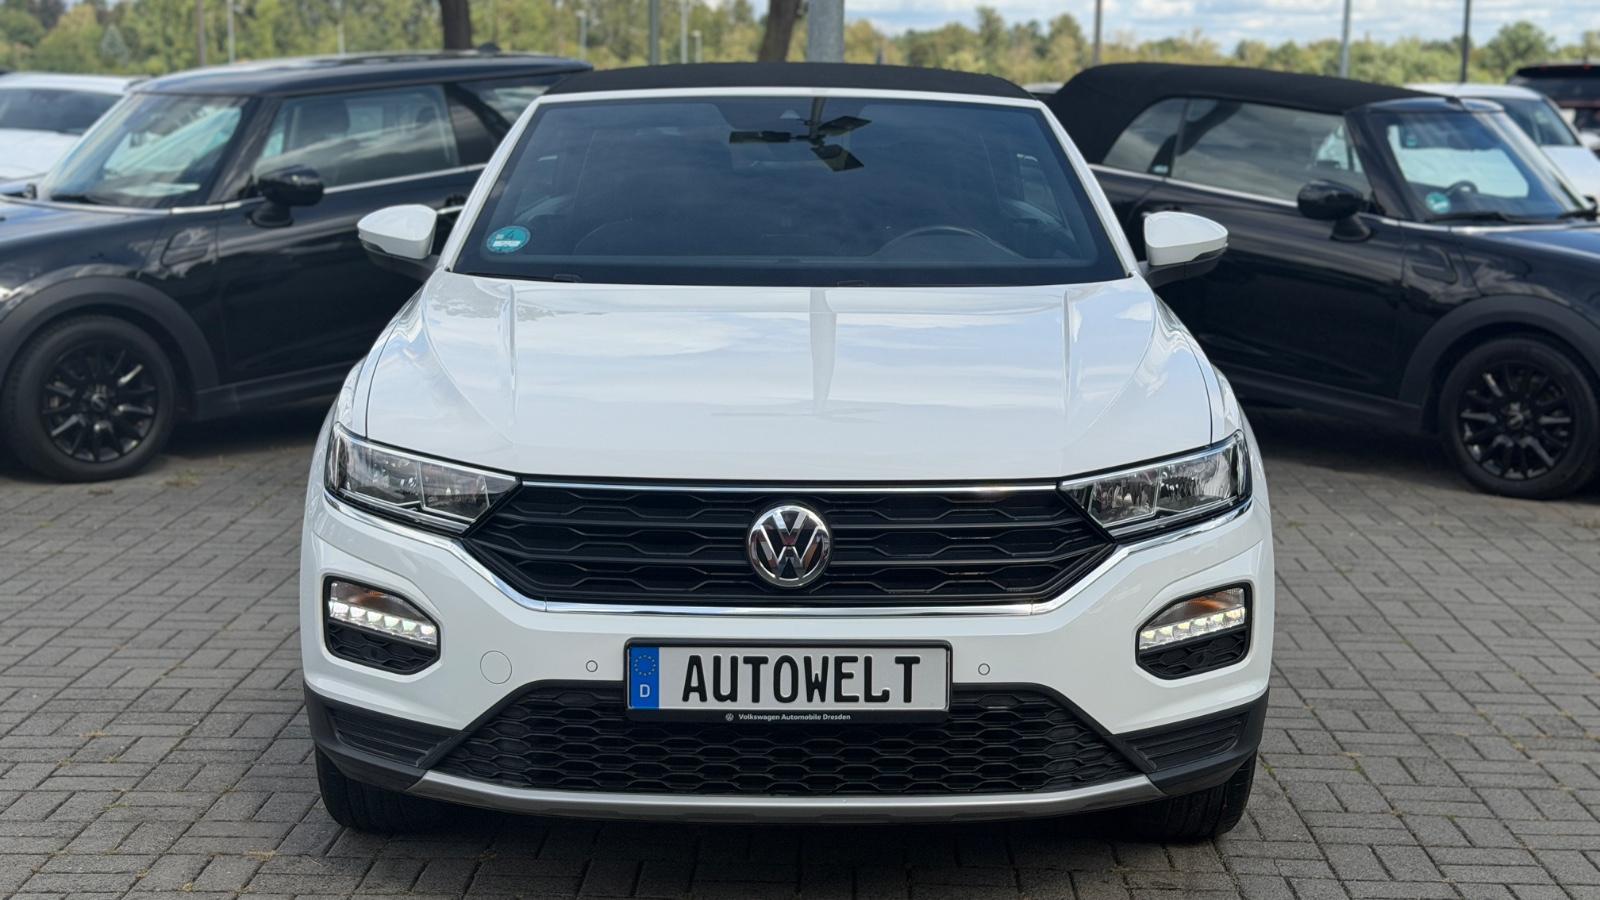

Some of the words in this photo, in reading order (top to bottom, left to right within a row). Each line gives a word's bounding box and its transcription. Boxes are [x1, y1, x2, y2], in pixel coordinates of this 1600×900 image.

[682, 655, 921, 703] AUTOWELT
[639, 684, 650, 698] D
[738, 713, 780, 721] Volkswagen
